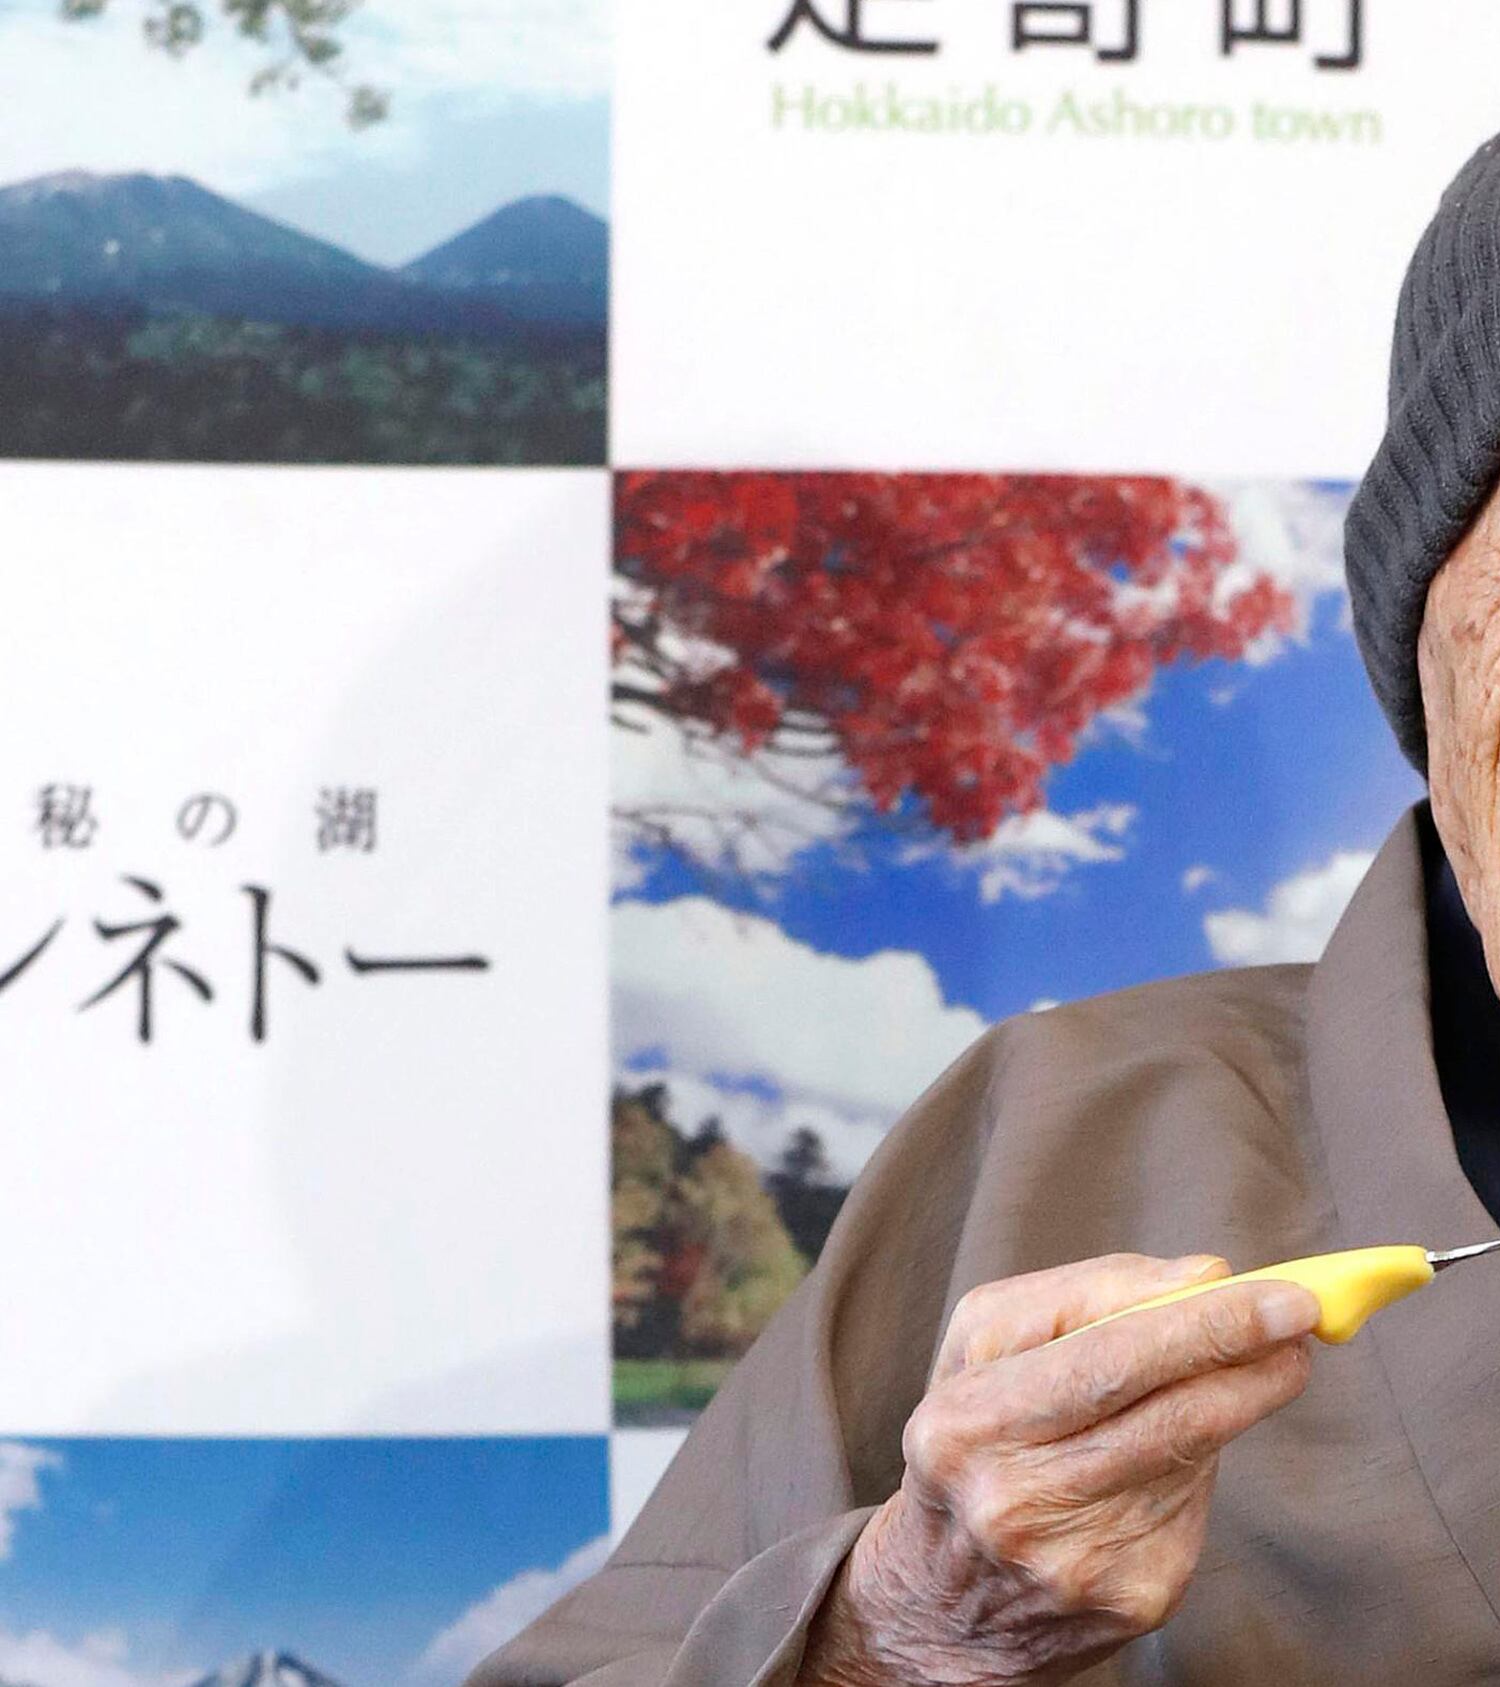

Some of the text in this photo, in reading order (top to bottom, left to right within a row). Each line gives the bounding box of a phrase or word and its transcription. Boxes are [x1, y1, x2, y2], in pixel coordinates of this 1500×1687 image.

[771, 82, 1384, 144] Hokkaido Ashoro town
[37, 783, 378, 853] 秘の湖
